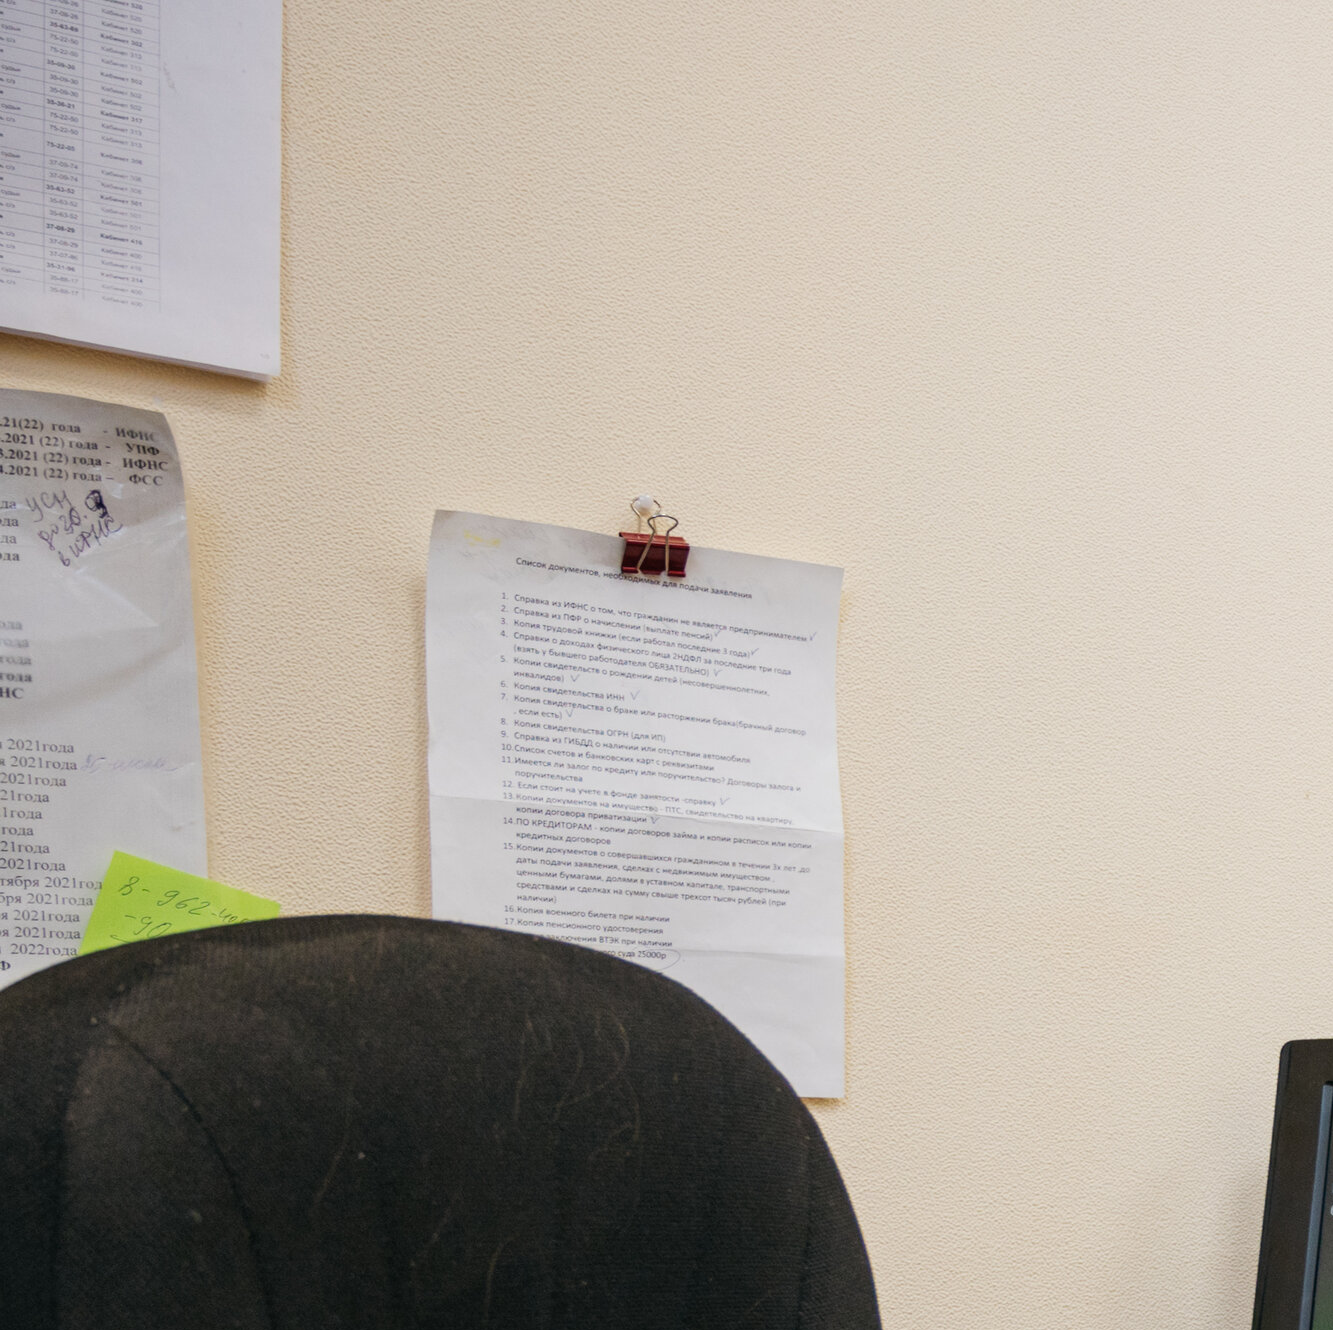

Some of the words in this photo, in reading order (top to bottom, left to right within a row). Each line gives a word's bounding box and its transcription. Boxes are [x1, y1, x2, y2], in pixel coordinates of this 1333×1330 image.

[51, 423, 81, 433] года
[115, 427, 159, 443] ИФНС
[39, 435, 65, 450] (22)
[69, 441, 99, 451] года
[125, 442, 160, 457] УПФ
[43, 452, 69, 466] (22)
[72, 456, 102, 467] года
[122, 457, 169, 473] ИФНС
[43, 468, 69, 481] (22)
[72, 472, 102, 483] года
[129, 474, 163, 487] ФСС
[516, 557, 547, 571] Список
[547, 563, 601, 579] документов,
[603, 572, 661, 588] необходимых
[662, 580, 678, 590] для
[679, 582, 709, 594] подачи
[710, 587, 753, 601] заявления
[514, 593, 550, 608] Справка
[551, 600, 561, 609] из
[563, 600, 589, 613] ИФНС
[617, 609, 632, 619] что
[633, 612, 678, 625] гражданин
[680, 619, 691, 627] не
[692, 620, 728, 633] является
[729, 624, 808, 643] предпринимателем
[513, 682, 541, 693] Копия
[542, 685, 605, 701] свидетельства
[606, 693, 625, 702] ИНН
[513, 719, 541, 730] Копия
[542, 722, 605, 737] свидетельства
[606, 729, 629, 739] ОГРН
[630, 731, 649, 742] (для
[650, 733, 667, 744] ИП)
[7, 738, 75, 754] 2021года
[10, 755, 78, 771] 2021года
[516, 817, 530, 827] ПО
[531, 818, 592, 832] КРЕДИТОРАМ
[26, 892, 94, 907] 2021года
[13, 908, 81, 924] 2021года
[516, 905, 544, 915] Копия
[546, 908, 586, 918] военного
[588, 910, 617, 921] билета
[618, 913, 634, 922] при
[635, 914, 670, 924] наличии
[14, 925, 82, 940] 2021года
[516, 918, 544, 928] Копия
[546, 920, 602, 932] пенсионного
[603, 924, 664, 936] удостоверения
[10, 942, 78, 957] 2022года
[619, 950, 636, 960] суда
[636, 949, 667, 961] 25000р
